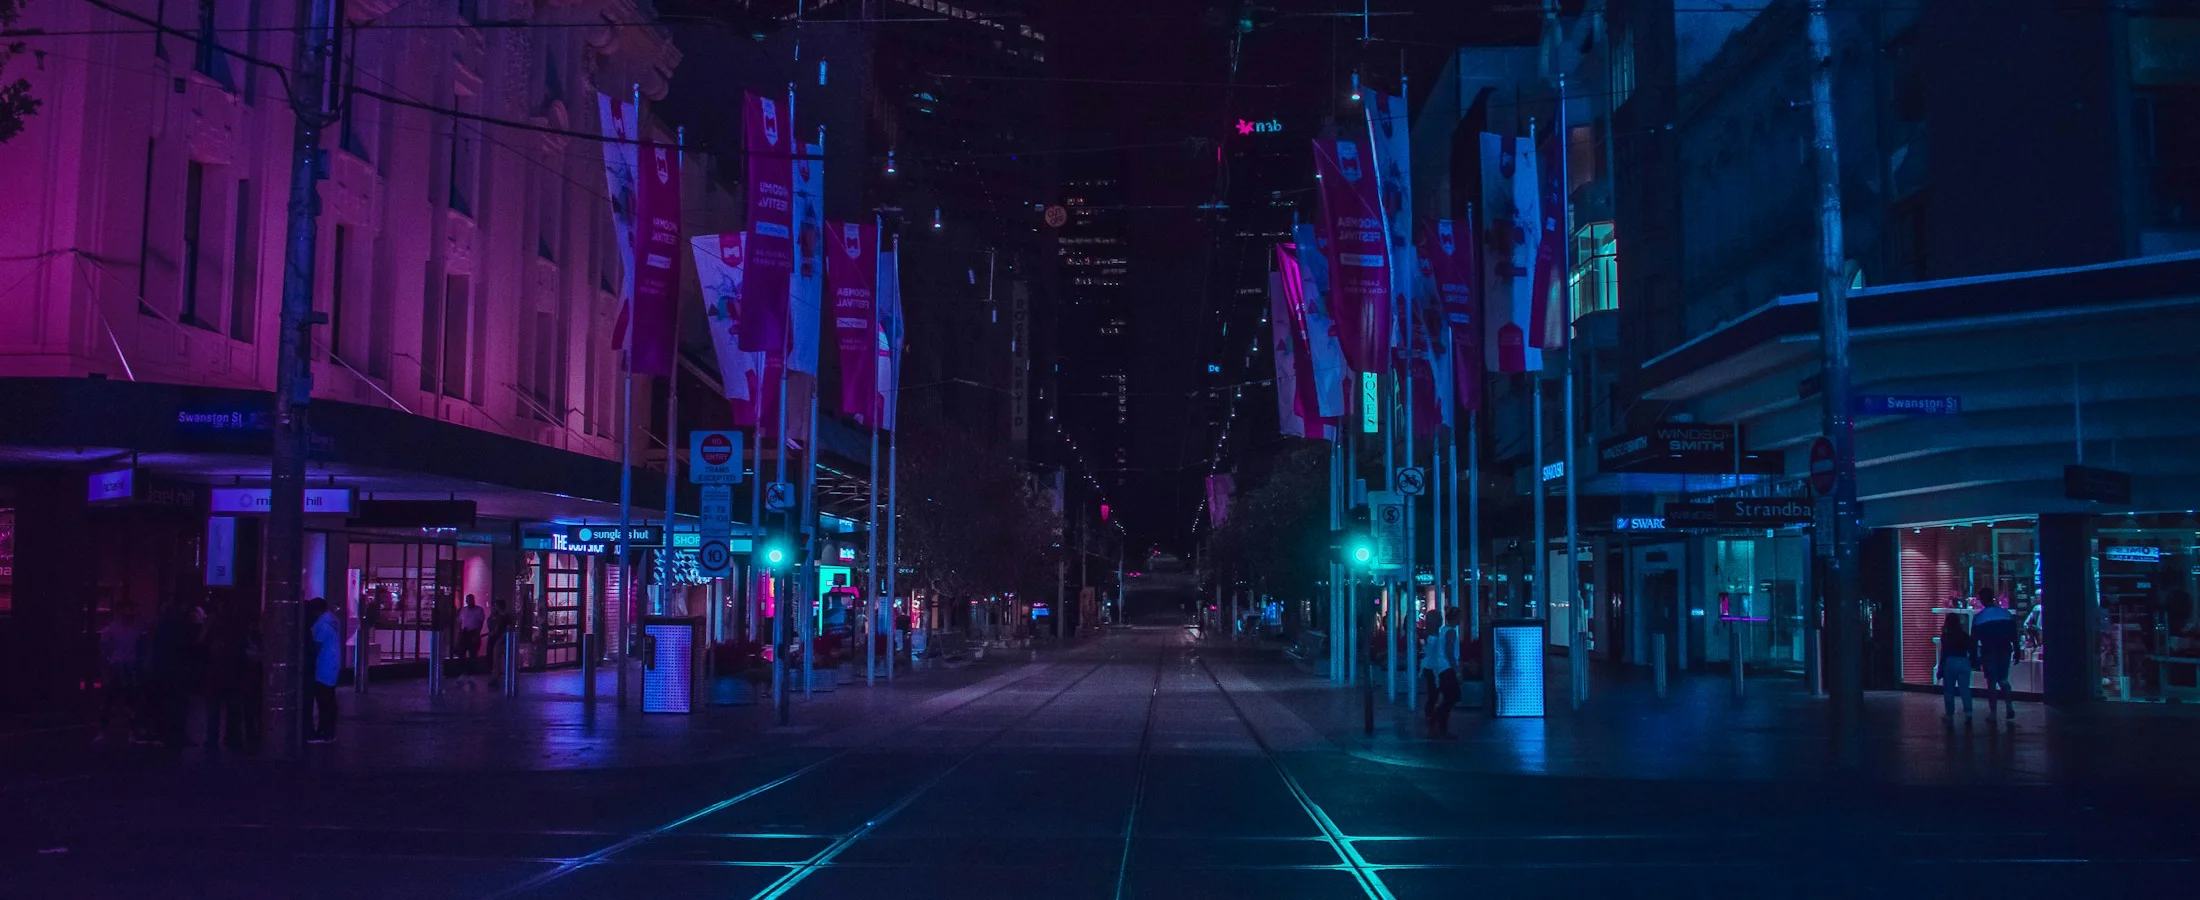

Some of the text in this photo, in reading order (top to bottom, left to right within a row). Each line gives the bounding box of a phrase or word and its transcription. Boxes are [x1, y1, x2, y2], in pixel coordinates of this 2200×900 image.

[1887, 397, 1944, 411] Swanston
[1946, 397, 1958, 409] St
[179, 411, 243, 424] Swanston St
[1669, 440, 1725, 452] SMITH
[306, 496, 322, 506] hill
[1735, 502, 1815, 519] Strandba
[633, 529, 649, 539] hut
[553, 533, 568, 551] THE
[709, 550, 724, 561] 10
